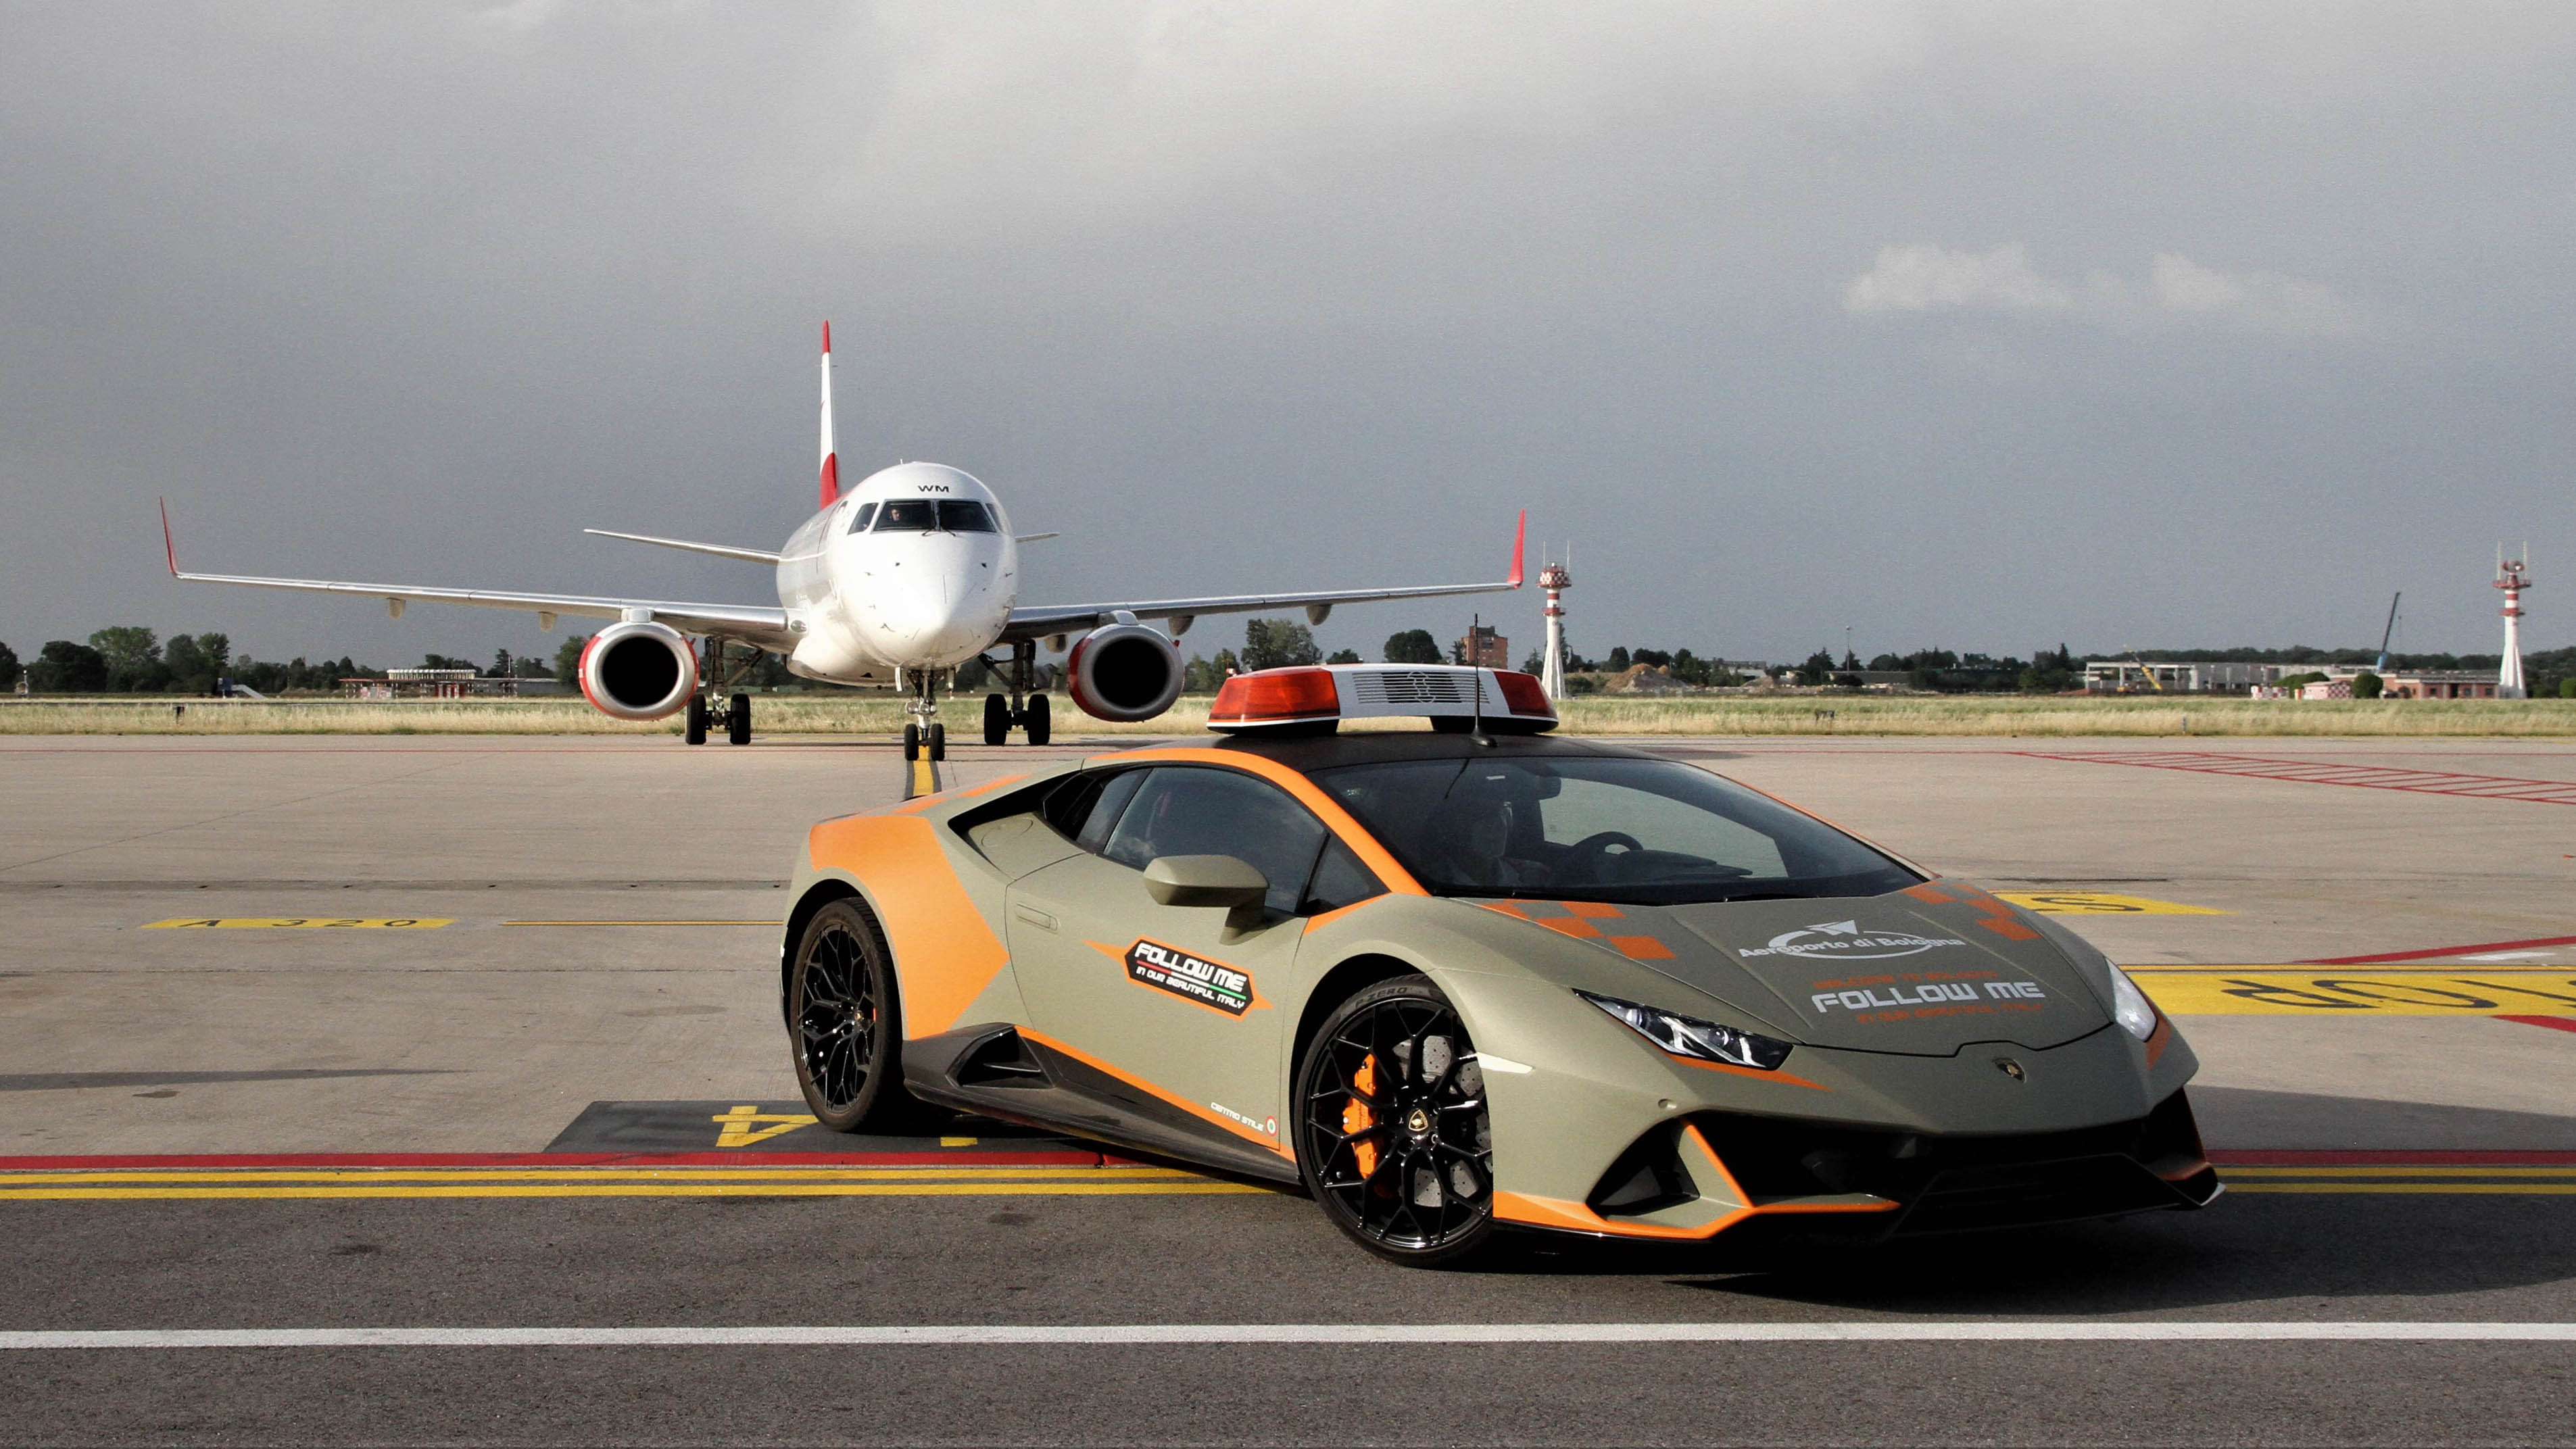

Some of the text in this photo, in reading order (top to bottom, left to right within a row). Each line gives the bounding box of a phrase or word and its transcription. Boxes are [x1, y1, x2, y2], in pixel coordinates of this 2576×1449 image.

[917, 485, 950, 493] WM
[1739, 937, 1966, 957] Aeroporto di Bologna
[1134, 942, 1247, 993] FOLLOW ME
[1136, 966, 1245, 1009] IN OUR BEAUTIFUL ITALY
[1811, 981, 2046, 1013] FOLLOW ME
[1211, 1102, 1263, 1131] CENTRO STILE
